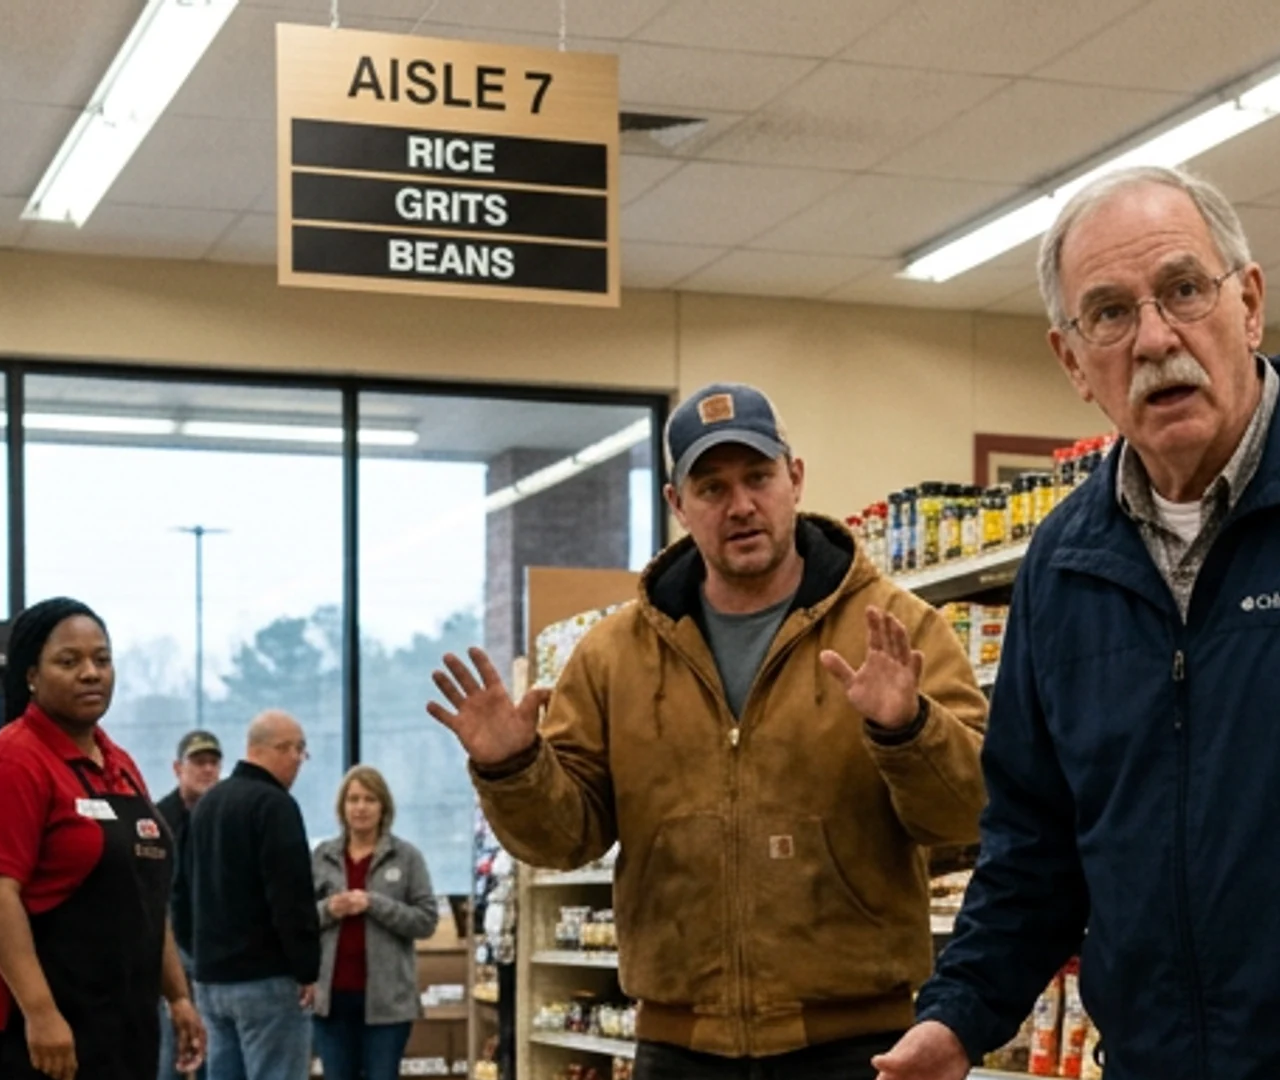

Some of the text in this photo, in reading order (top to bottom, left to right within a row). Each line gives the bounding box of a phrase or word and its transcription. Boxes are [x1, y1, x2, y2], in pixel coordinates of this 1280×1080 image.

[347, 56, 553, 114] AISLE 7
[407, 135, 495, 173] RICE
[395, 187, 508, 226] GRITS
[388, 239, 515, 278] BEANS
